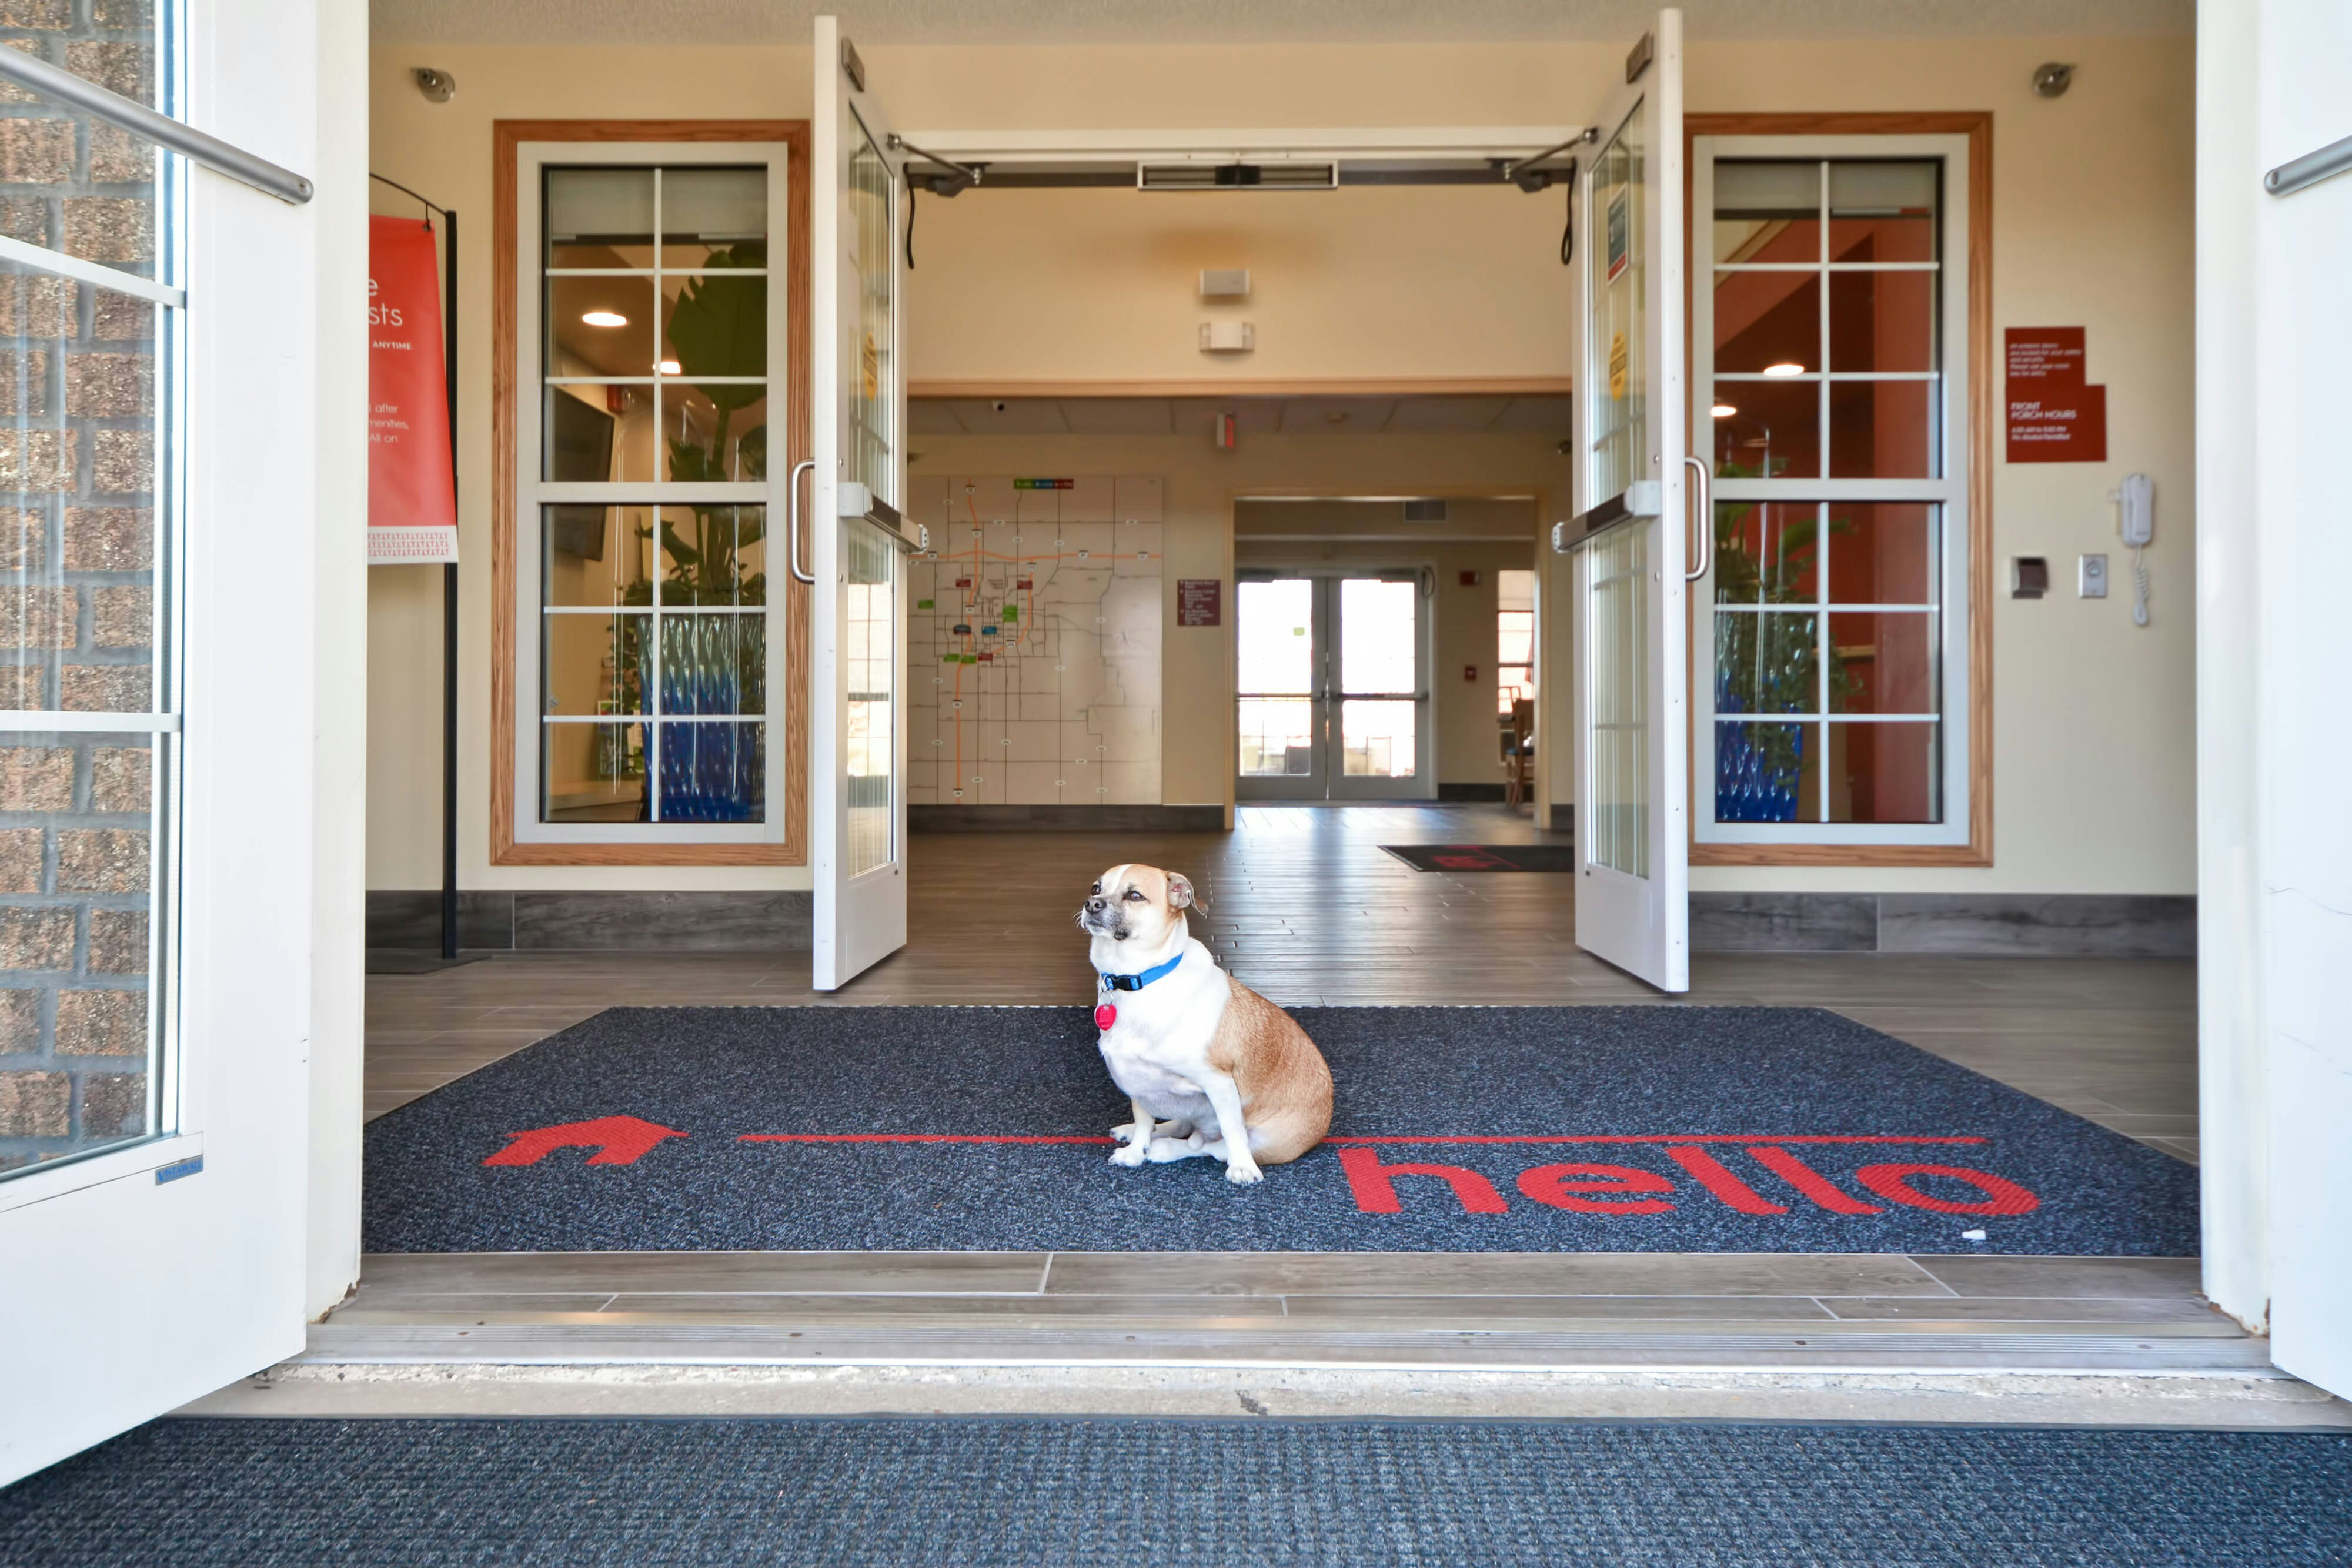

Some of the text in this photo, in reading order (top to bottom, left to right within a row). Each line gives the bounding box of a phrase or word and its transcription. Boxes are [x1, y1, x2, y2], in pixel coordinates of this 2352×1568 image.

[373, 340, 414, 350] ANYTIME.
[375, 404, 398, 413] after
[1338, 1147, 2040, 1215] hello
